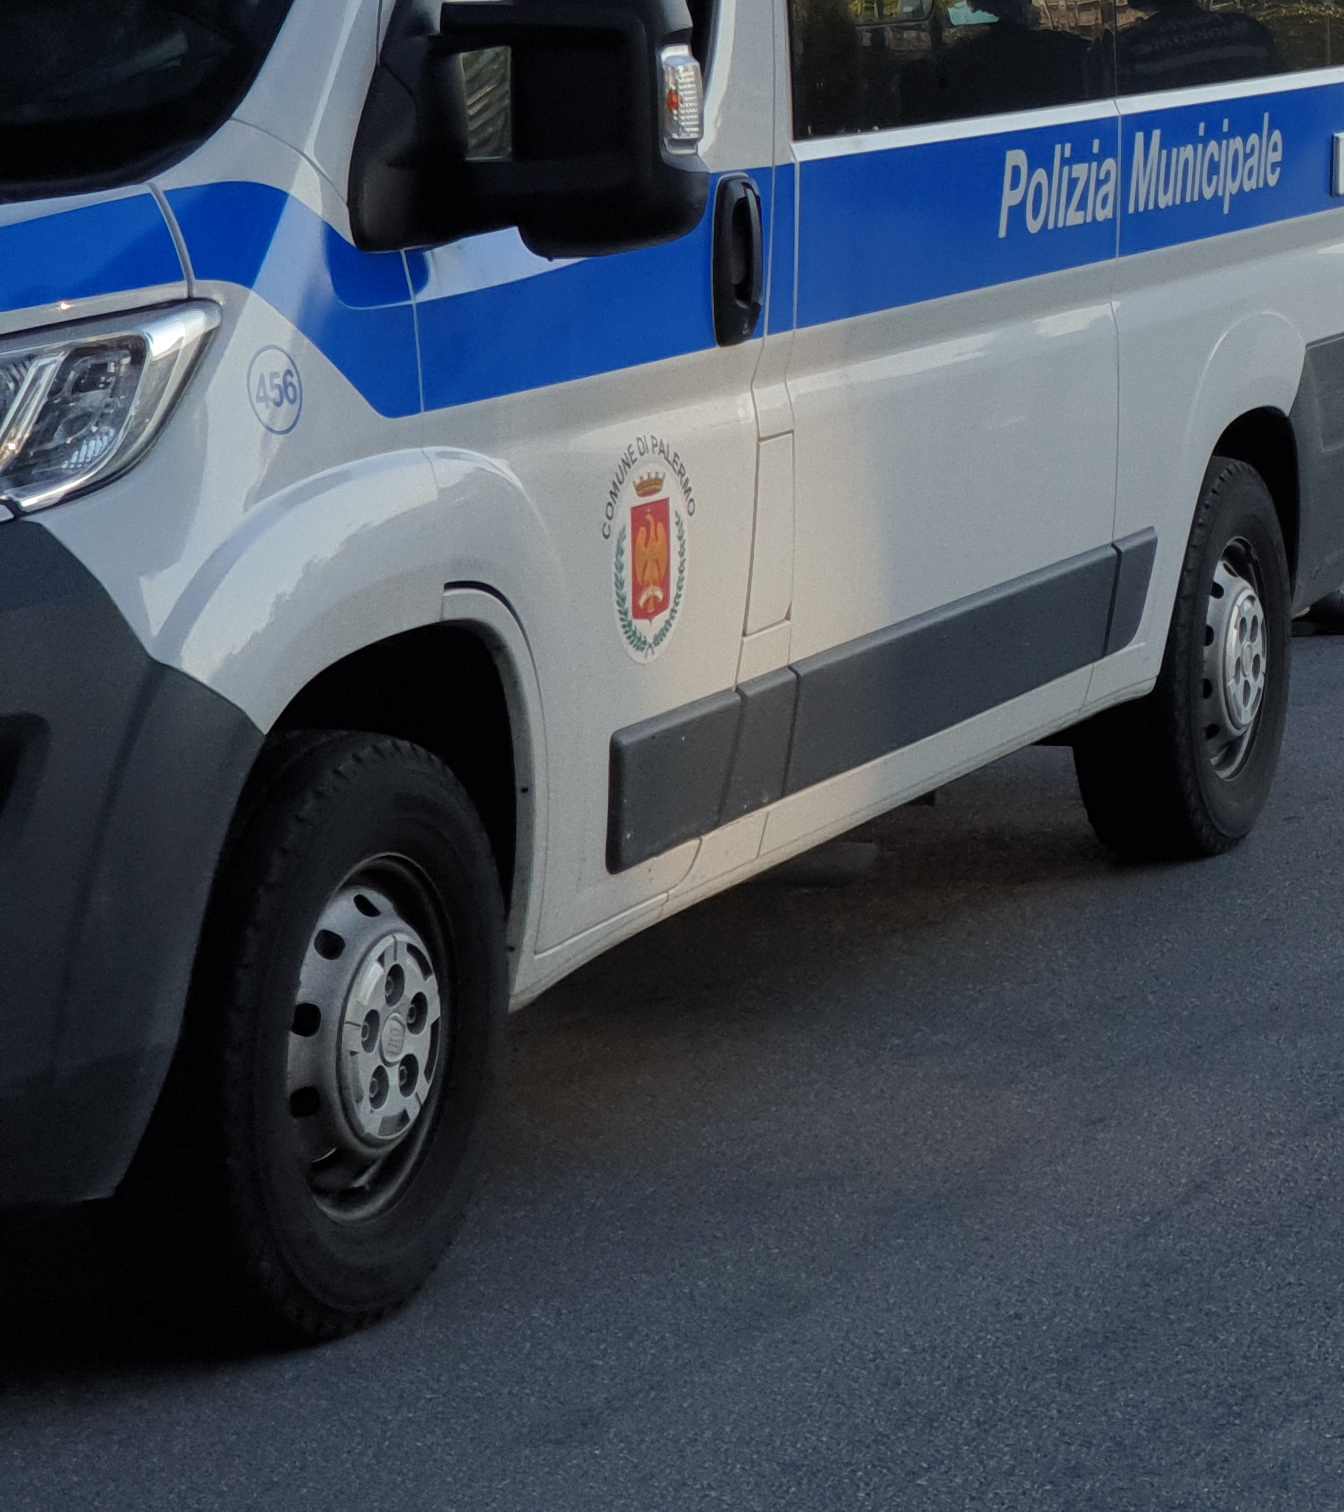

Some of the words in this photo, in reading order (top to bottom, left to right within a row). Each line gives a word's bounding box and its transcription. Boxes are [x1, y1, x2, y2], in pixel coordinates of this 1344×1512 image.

[998, 138, 1117, 239] Polizia
[1128, 112, 1283, 215] Municipale
[255, 368, 298, 409] 456
[601, 443, 638, 540] COMUNE
[636, 434, 650, 457] DI
[650, 434, 696, 517] PALERMO
